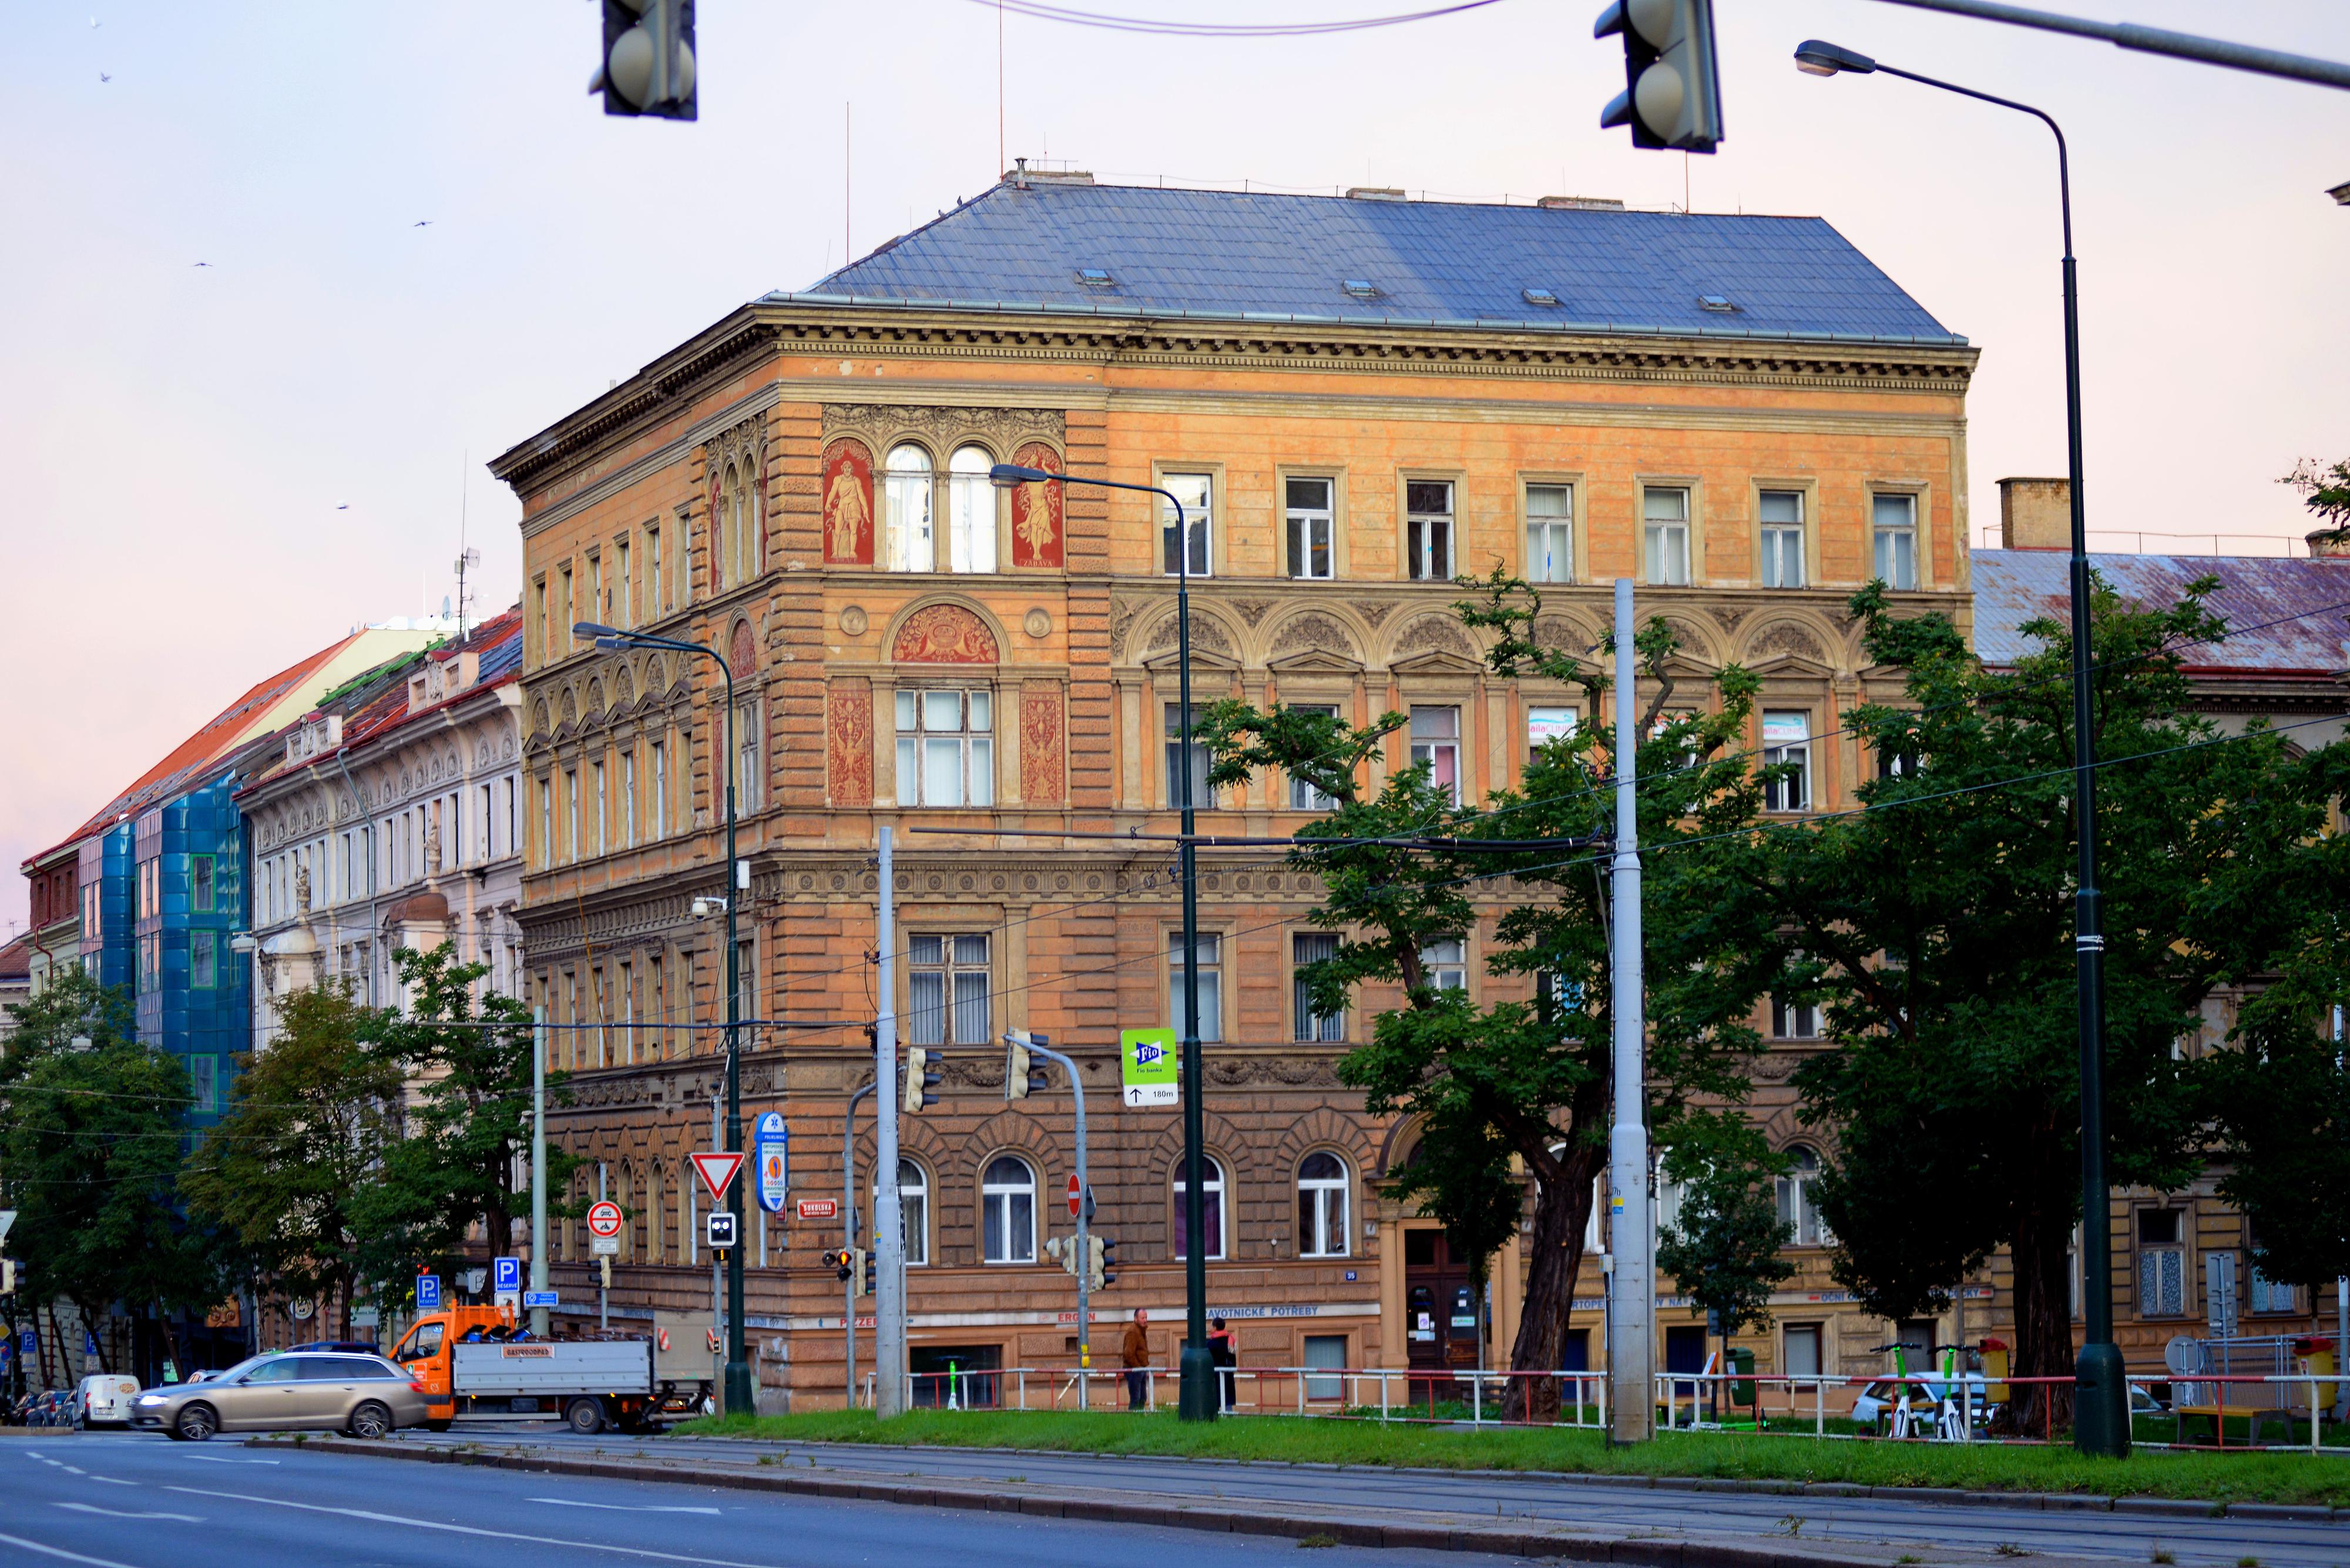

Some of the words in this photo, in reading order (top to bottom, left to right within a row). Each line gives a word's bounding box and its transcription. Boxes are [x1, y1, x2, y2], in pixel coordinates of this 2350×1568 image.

[1140, 1046, 1158, 1062] Fio
[803, 1203, 831, 1211] SOKOLSKÁ
[501, 1262, 514, 1282] P
[1058, 1312, 1095, 1322] ERGN
[1206, 1306, 1265, 1318] AVOTNICKÉ
[1271, 1305, 1318, 1317] POTŘEBY
